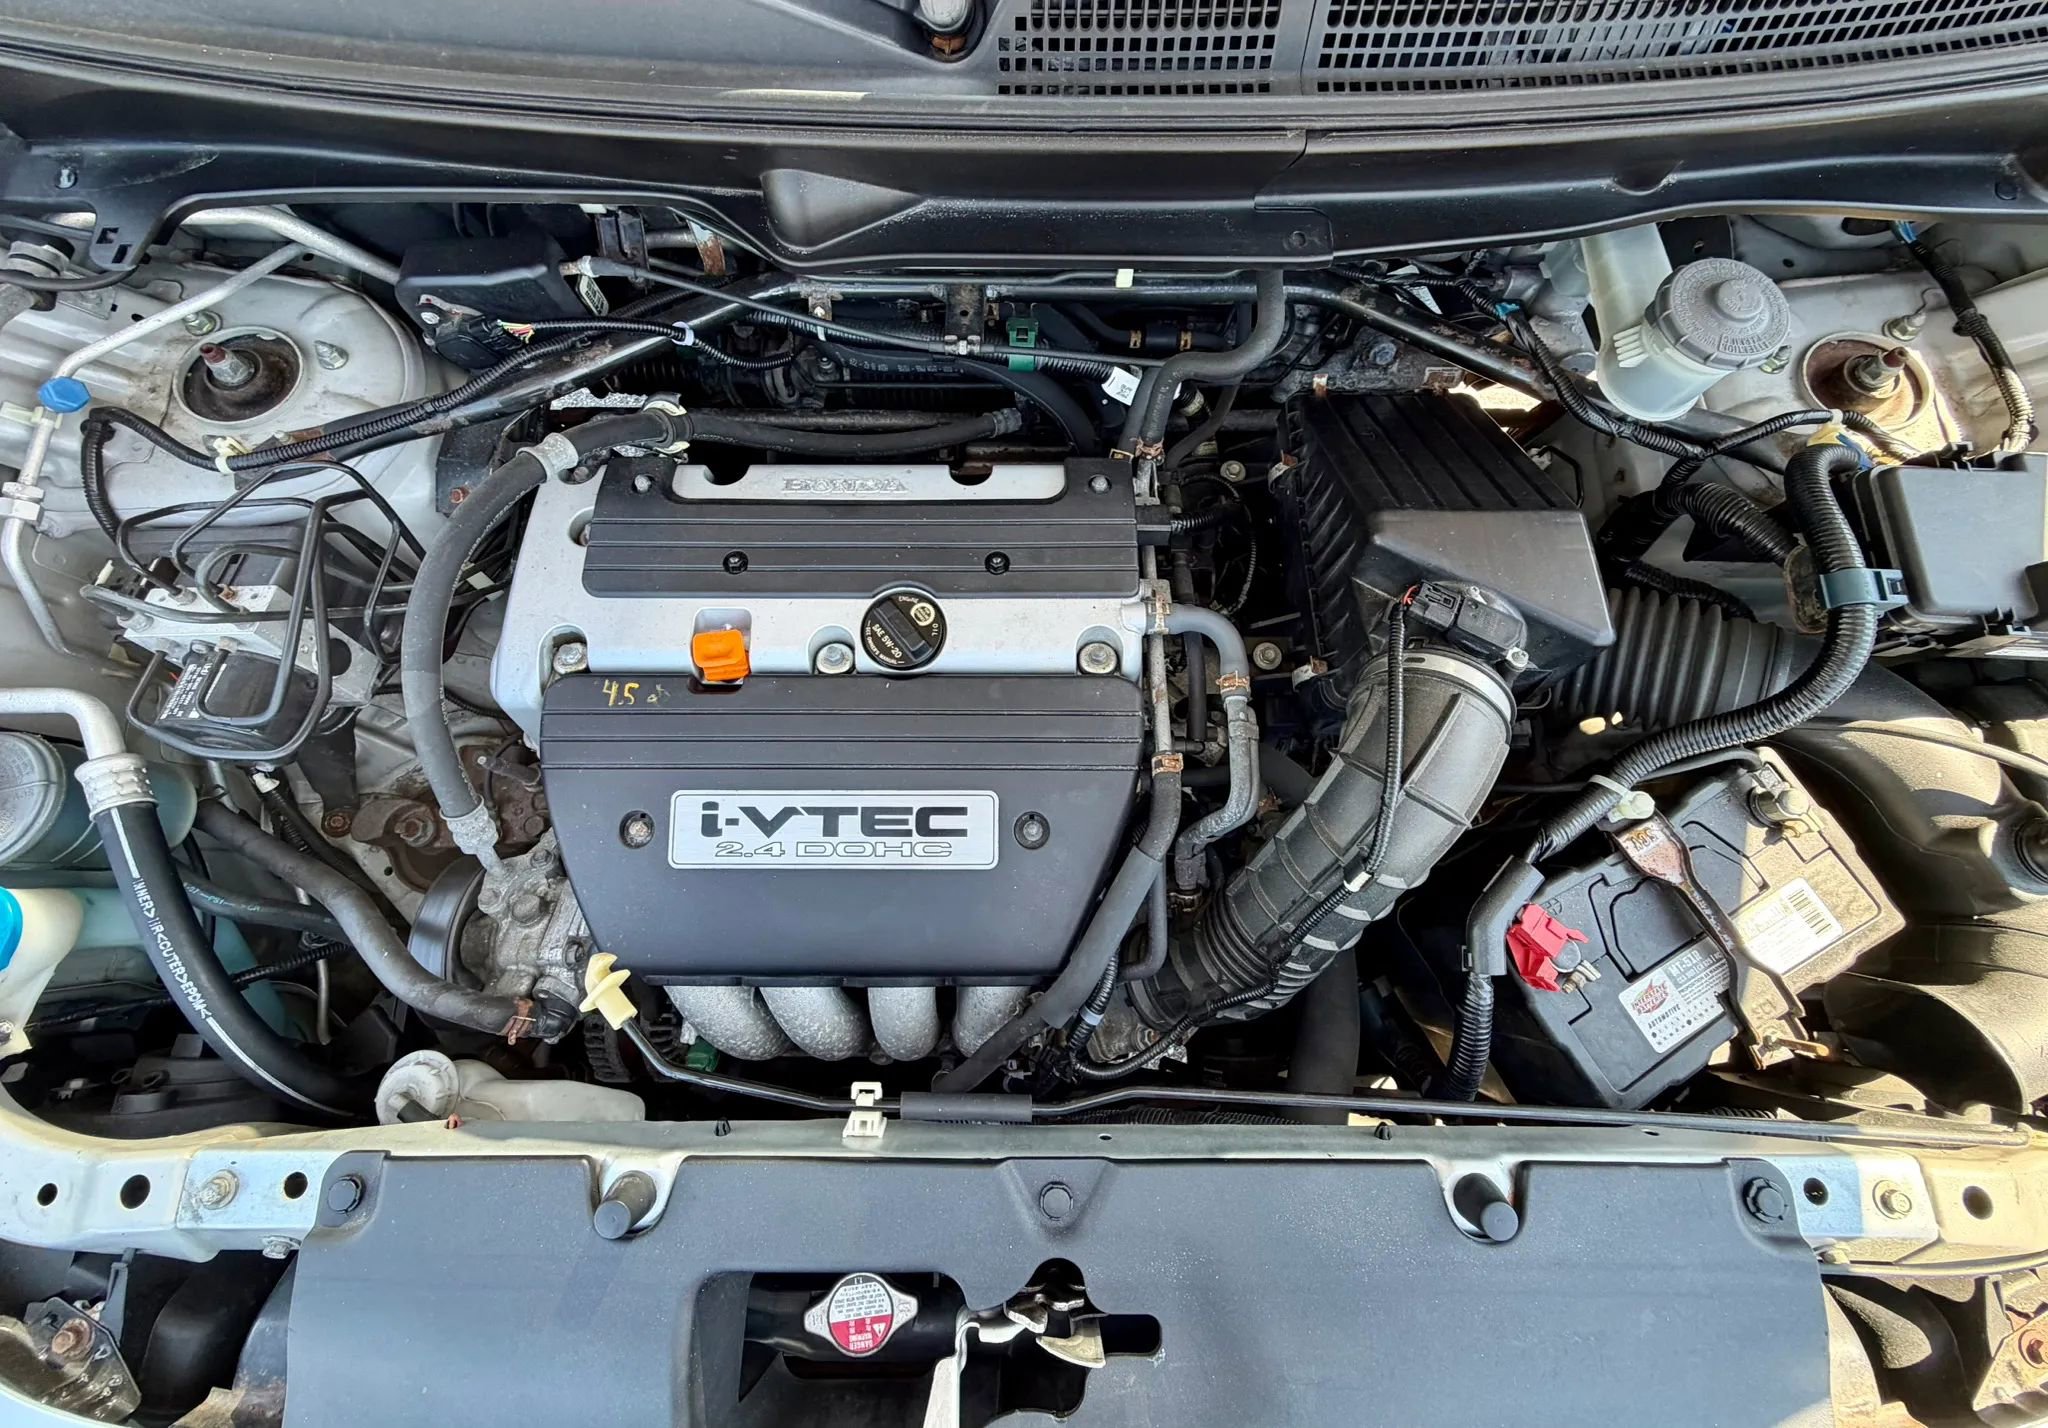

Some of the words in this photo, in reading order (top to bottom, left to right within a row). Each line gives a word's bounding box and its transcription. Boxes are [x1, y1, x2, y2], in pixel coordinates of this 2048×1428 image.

[781, 477, 909, 494] HONDA
[872, 623, 884, 638] SAE
[881, 635, 902, 658] 5W-20
[931, 623, 940, 636] OIL
[602, 678, 640, 706] 4.5
[701, 801, 968, 838] i-VTEC
[715, 842, 785, 858] 2.4
[796, 842, 953, 858] DOHC
[1631, 982, 1668, 1010] INTERSTATE
[1637, 989, 1669, 1016] BATTERIES
[1647, 1003, 1681, 1029] AUTOMOTIVE
[848, 1340, 873, 1350] DANGER
